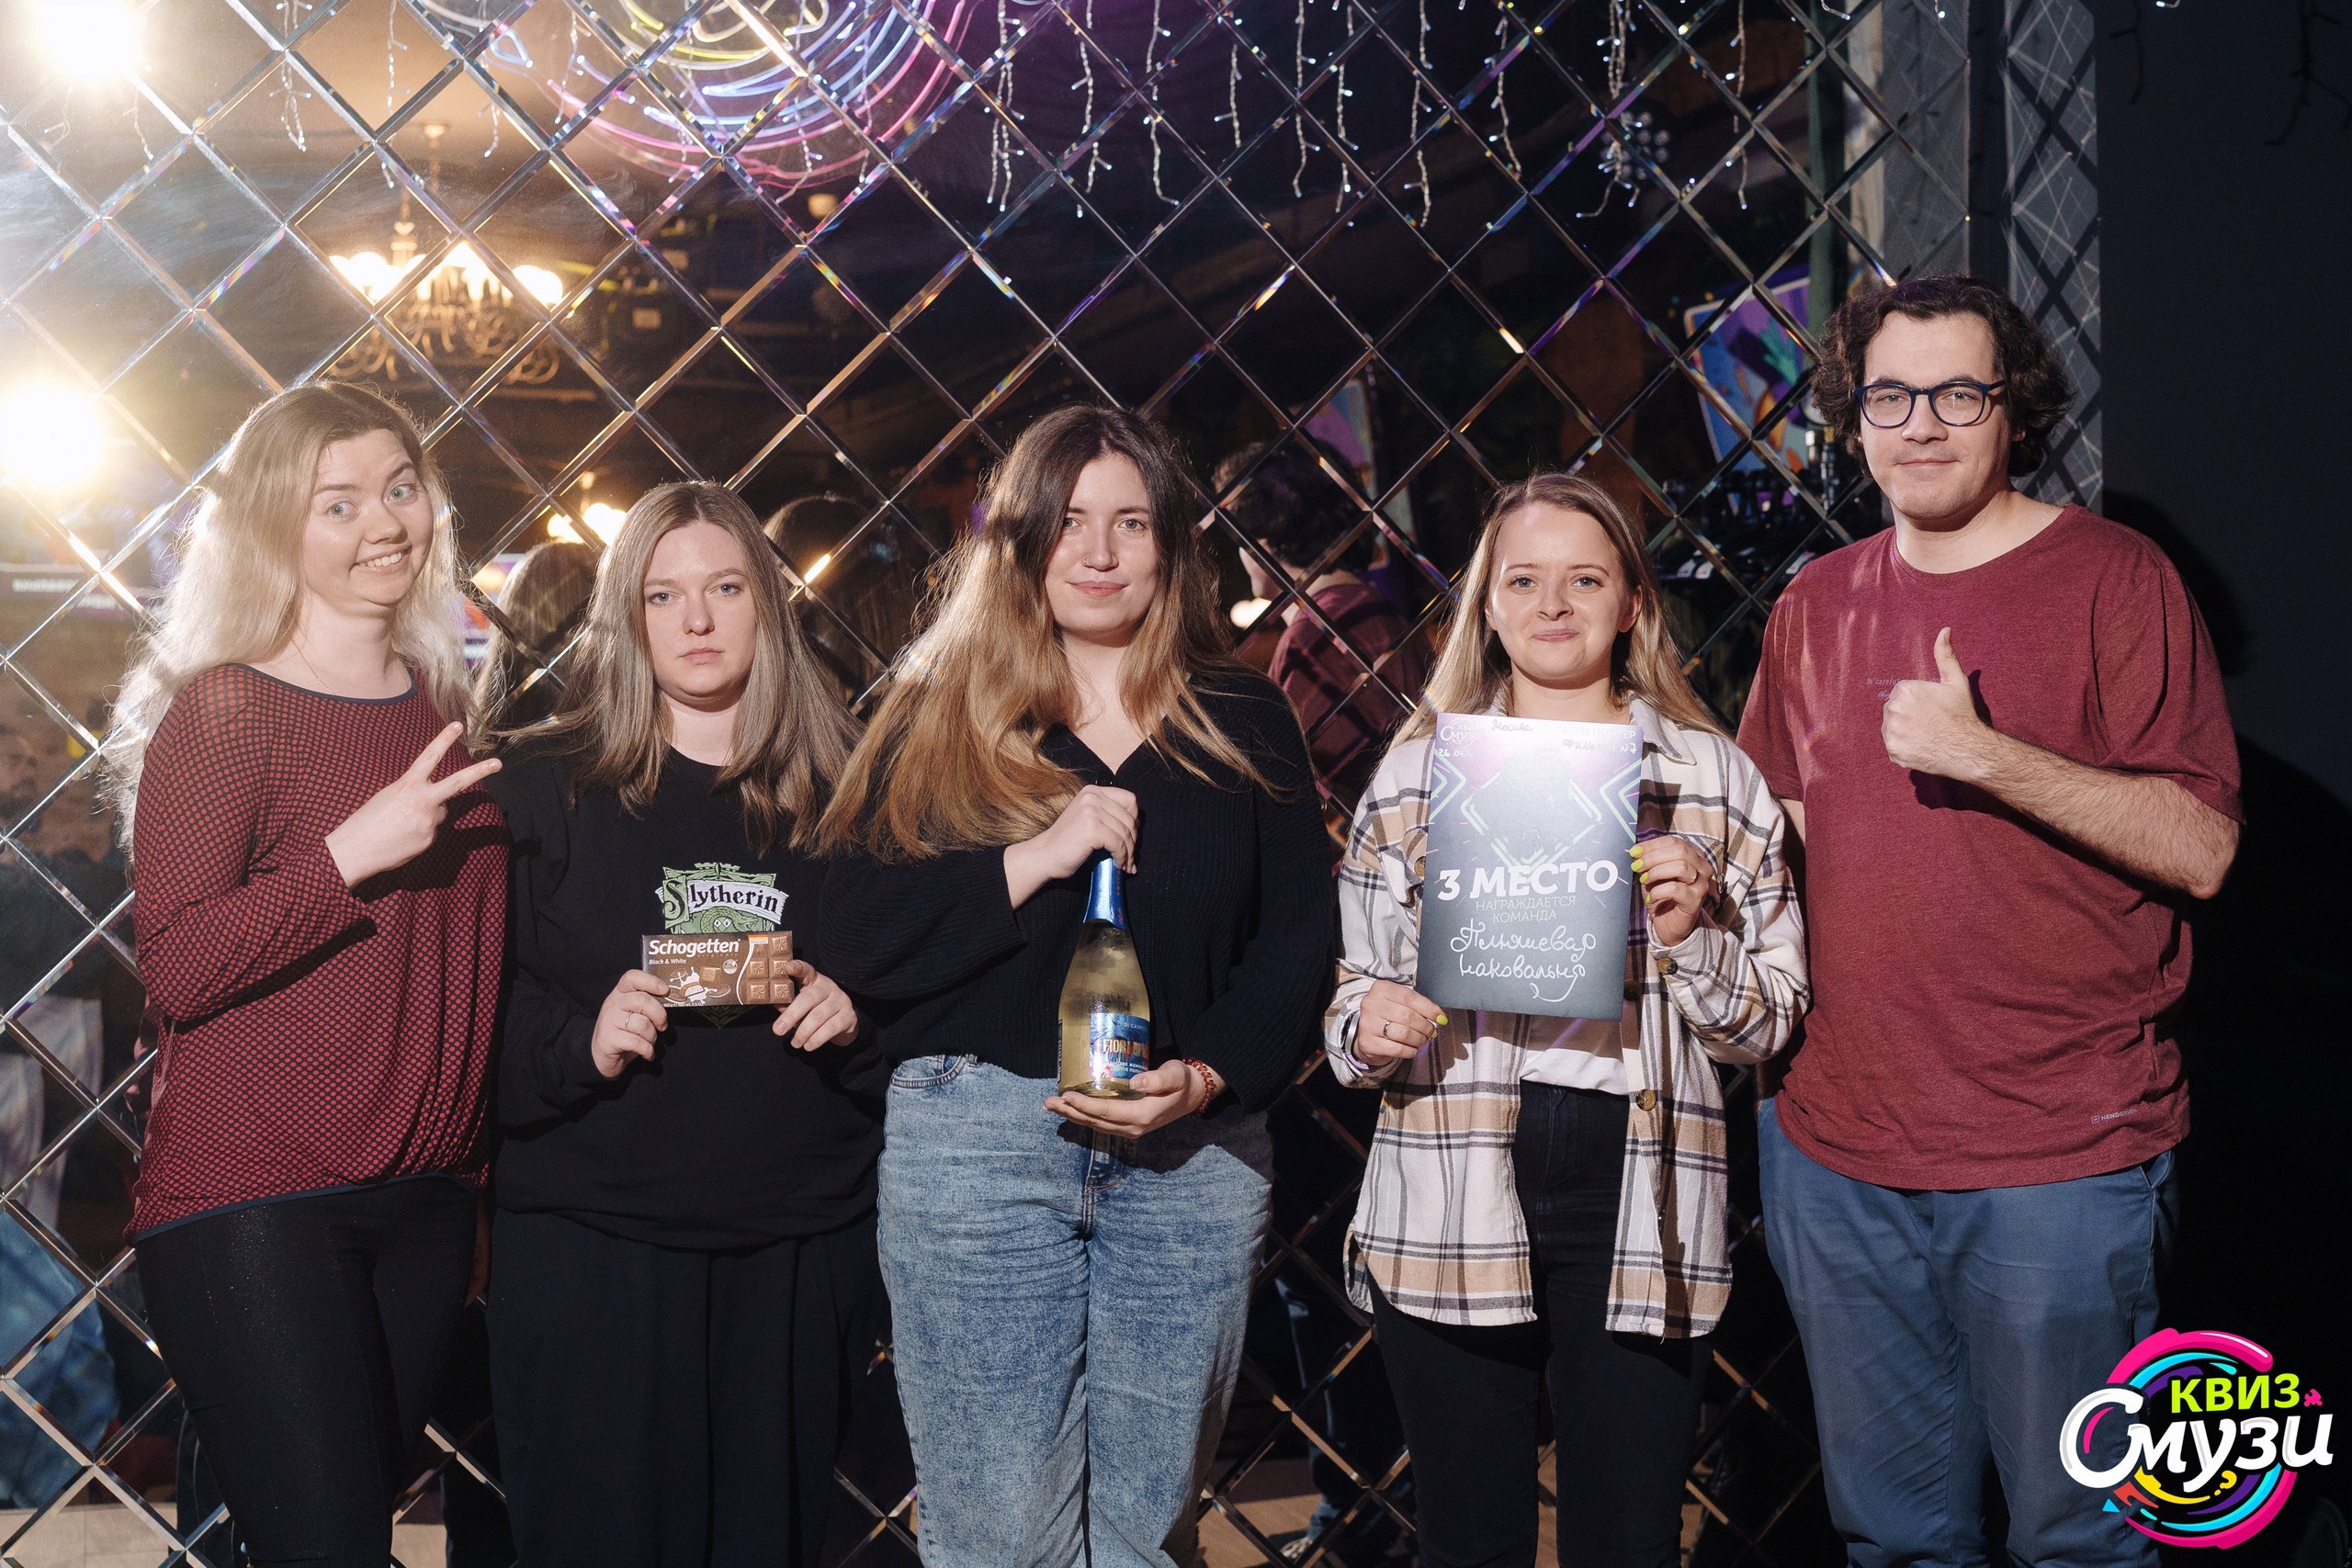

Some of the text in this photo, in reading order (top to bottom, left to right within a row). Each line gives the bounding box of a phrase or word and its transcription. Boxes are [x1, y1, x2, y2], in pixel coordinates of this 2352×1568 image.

[1556, 726, 1589, 736] ГАРРИ
[1437, 860, 1619, 901] 3 МЕСТО
[663, 880, 779, 920] Slytherin
[1476, 895, 1577, 911] НАГРАЖДАЕТСЯ
[1492, 909, 1557, 924] КОМАНДА
[648, 938, 741, 958] Schogetten
